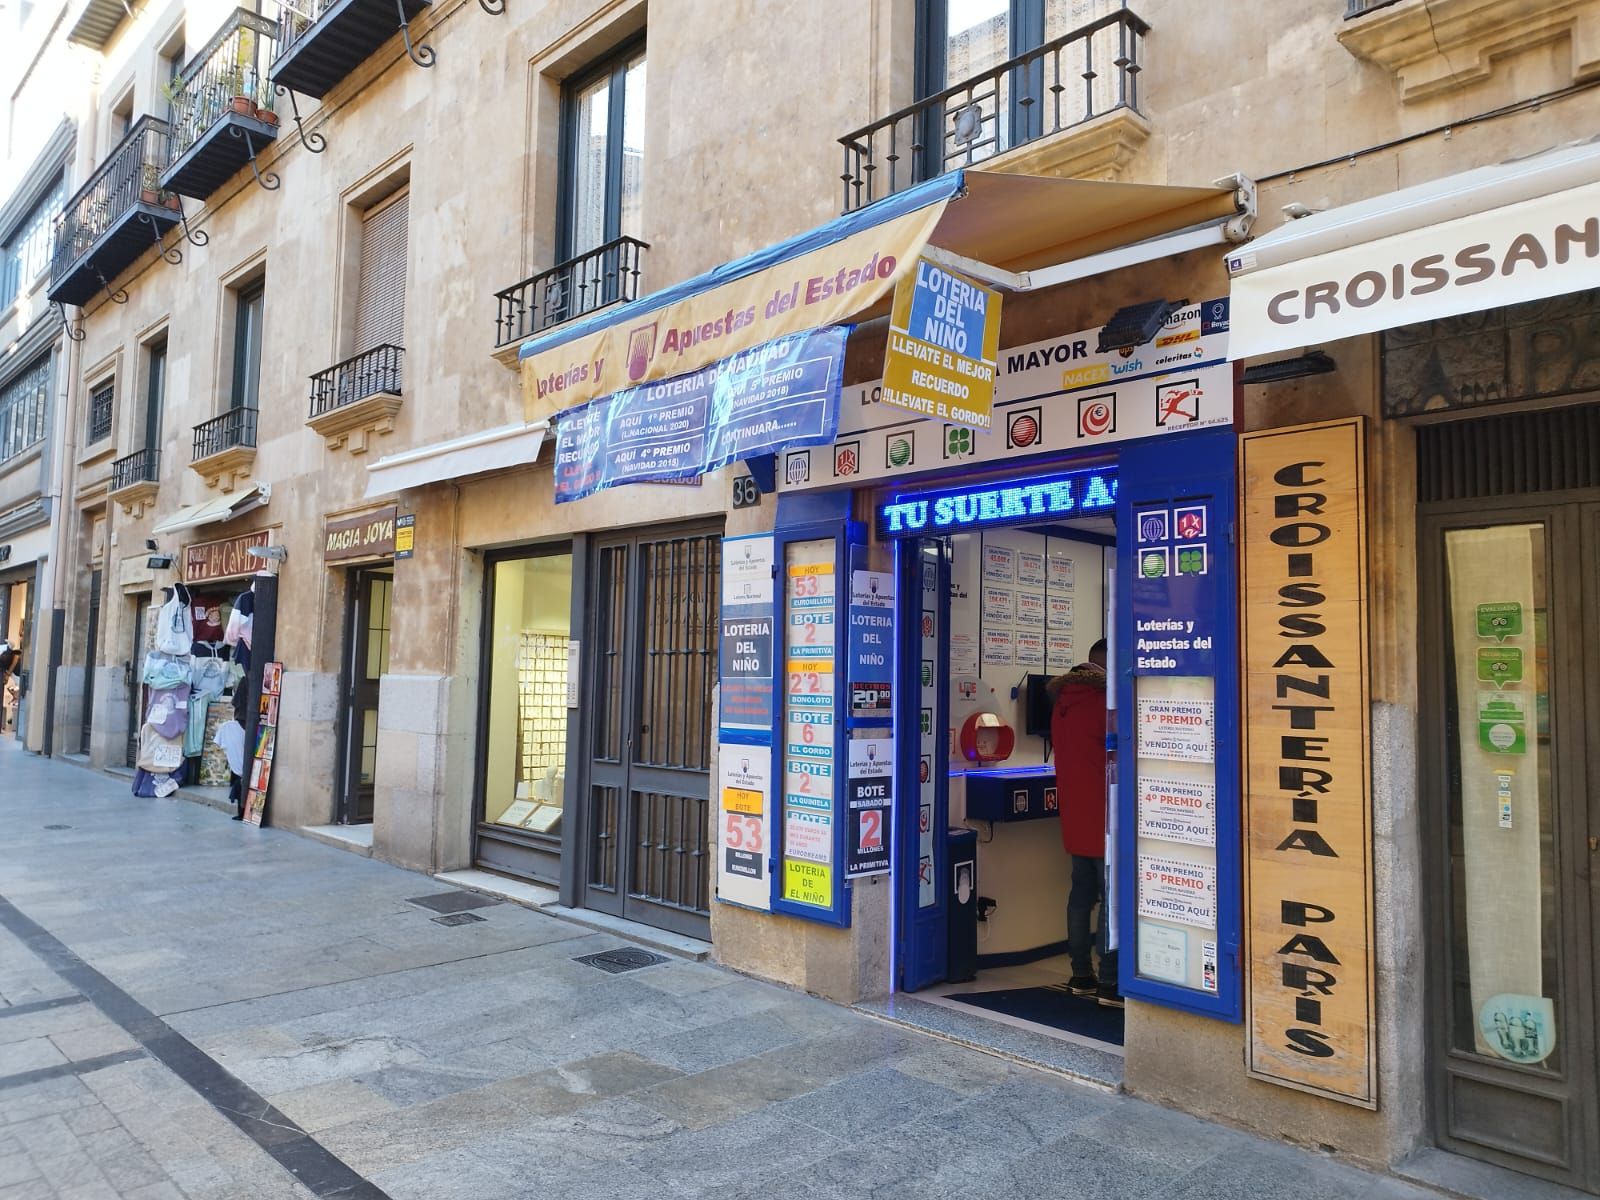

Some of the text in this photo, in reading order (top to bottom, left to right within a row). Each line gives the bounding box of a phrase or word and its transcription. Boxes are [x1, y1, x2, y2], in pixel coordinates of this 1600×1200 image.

[1267, 217, 1600, 325] CROISSAN
[916, 261, 985, 315] LOTERIA
[934, 294, 965, 328] DEL
[536, 255, 897, 399] Loterías y Apuestas del Estado
[892, 336, 940, 366] LLEVATE
[942, 354, 954, 370] EL
[956, 359, 992, 382] MEJOR
[1007, 340, 1088, 374] MAYOR
[1156, 352, 1192, 365] celeritas
[1111, 358, 1143, 375] wish
[763, 367, 804, 387] PREMIO
[647, 373, 705, 401] LOTERIA
[911, 370, 969, 399] RECUERDO
[767, 385, 789, 399] 2018)
[659, 405, 694, 422] PREMIO
[937, 402, 949, 417] EL
[670, 419, 690, 432] 2020)
[562, 437, 574, 448] EL
[641, 447, 651, 458] 4º
[653, 442, 691, 457] PREMIO
[622, 460, 657, 473] (NAVIDAD
[733, 478, 757, 506] 36
[884, 500, 929, 530] TU
[934, 480, 1075, 525] SUERTE
[326, 528, 360, 551] MAGIA
[363, 520, 393, 545] JOYA
[795, 576, 818, 596] 53
[794, 613, 831, 625] BOTE
[852, 614, 892, 627] LOTERIA
[1137, 619, 1194, 633] Loterías y
[724, 623, 770, 637] LOTERIA
[804, 624, 816, 643] 2
[863, 633, 882, 644] DEL
[1137, 637, 1211, 652] Apuestas del
[736, 641, 757, 654] DEL
[802, 647, 832, 655] PRIMITIVA
[732, 657, 760, 672] NIÑO
[859, 653, 884, 665] NIÑO
[1138, 657, 1176, 668] Estado
[1269, 461, 1340, 858] CROISSANTERÍA
[802, 663, 817, 671] HOY
[791, 696, 831, 704] BONOLOTO
[1149, 705, 1202, 715] GRAN PREMIO
[793, 712, 830, 723] BOTE
[1160, 716, 1202, 726] PREMIO
[802, 724, 814, 743] 6
[802, 746, 831, 756] GORDO
[1145, 741, 1208, 751] VENDIDO AQUÍ
[792, 762, 829, 776] BOTE
[800, 773, 811, 793] 2
[737, 792, 749, 800] HOY
[857, 786, 885, 798] BOTE
[1149, 786, 1202, 797] GRAN PREMIO
[789, 796, 829, 808] LA QUINIELA
[1160, 795, 1202, 808] PREMIO
[726, 814, 763, 853] 53
[860, 810, 881, 849] 2
[1145, 820, 1184, 832] VENDIDO
[1186, 826, 1209, 835] AQUÍ
[857, 845, 884, 854] MILLONES
[789, 865, 826, 878] LOTERIA
[850, 859, 889, 871] LA PRIMITIVA
[1150, 864, 1204, 878] GRAN PREMIO
[802, 879, 814, 888] DE
[1161, 876, 1204, 890] PREMIO
[790, 889, 825, 903] EL NIÑO
[1146, 899, 1185, 912] VENDIDO
[1187, 906, 1210, 917] AQUÍ
[1276, 899, 1342, 1058] PARÍS
